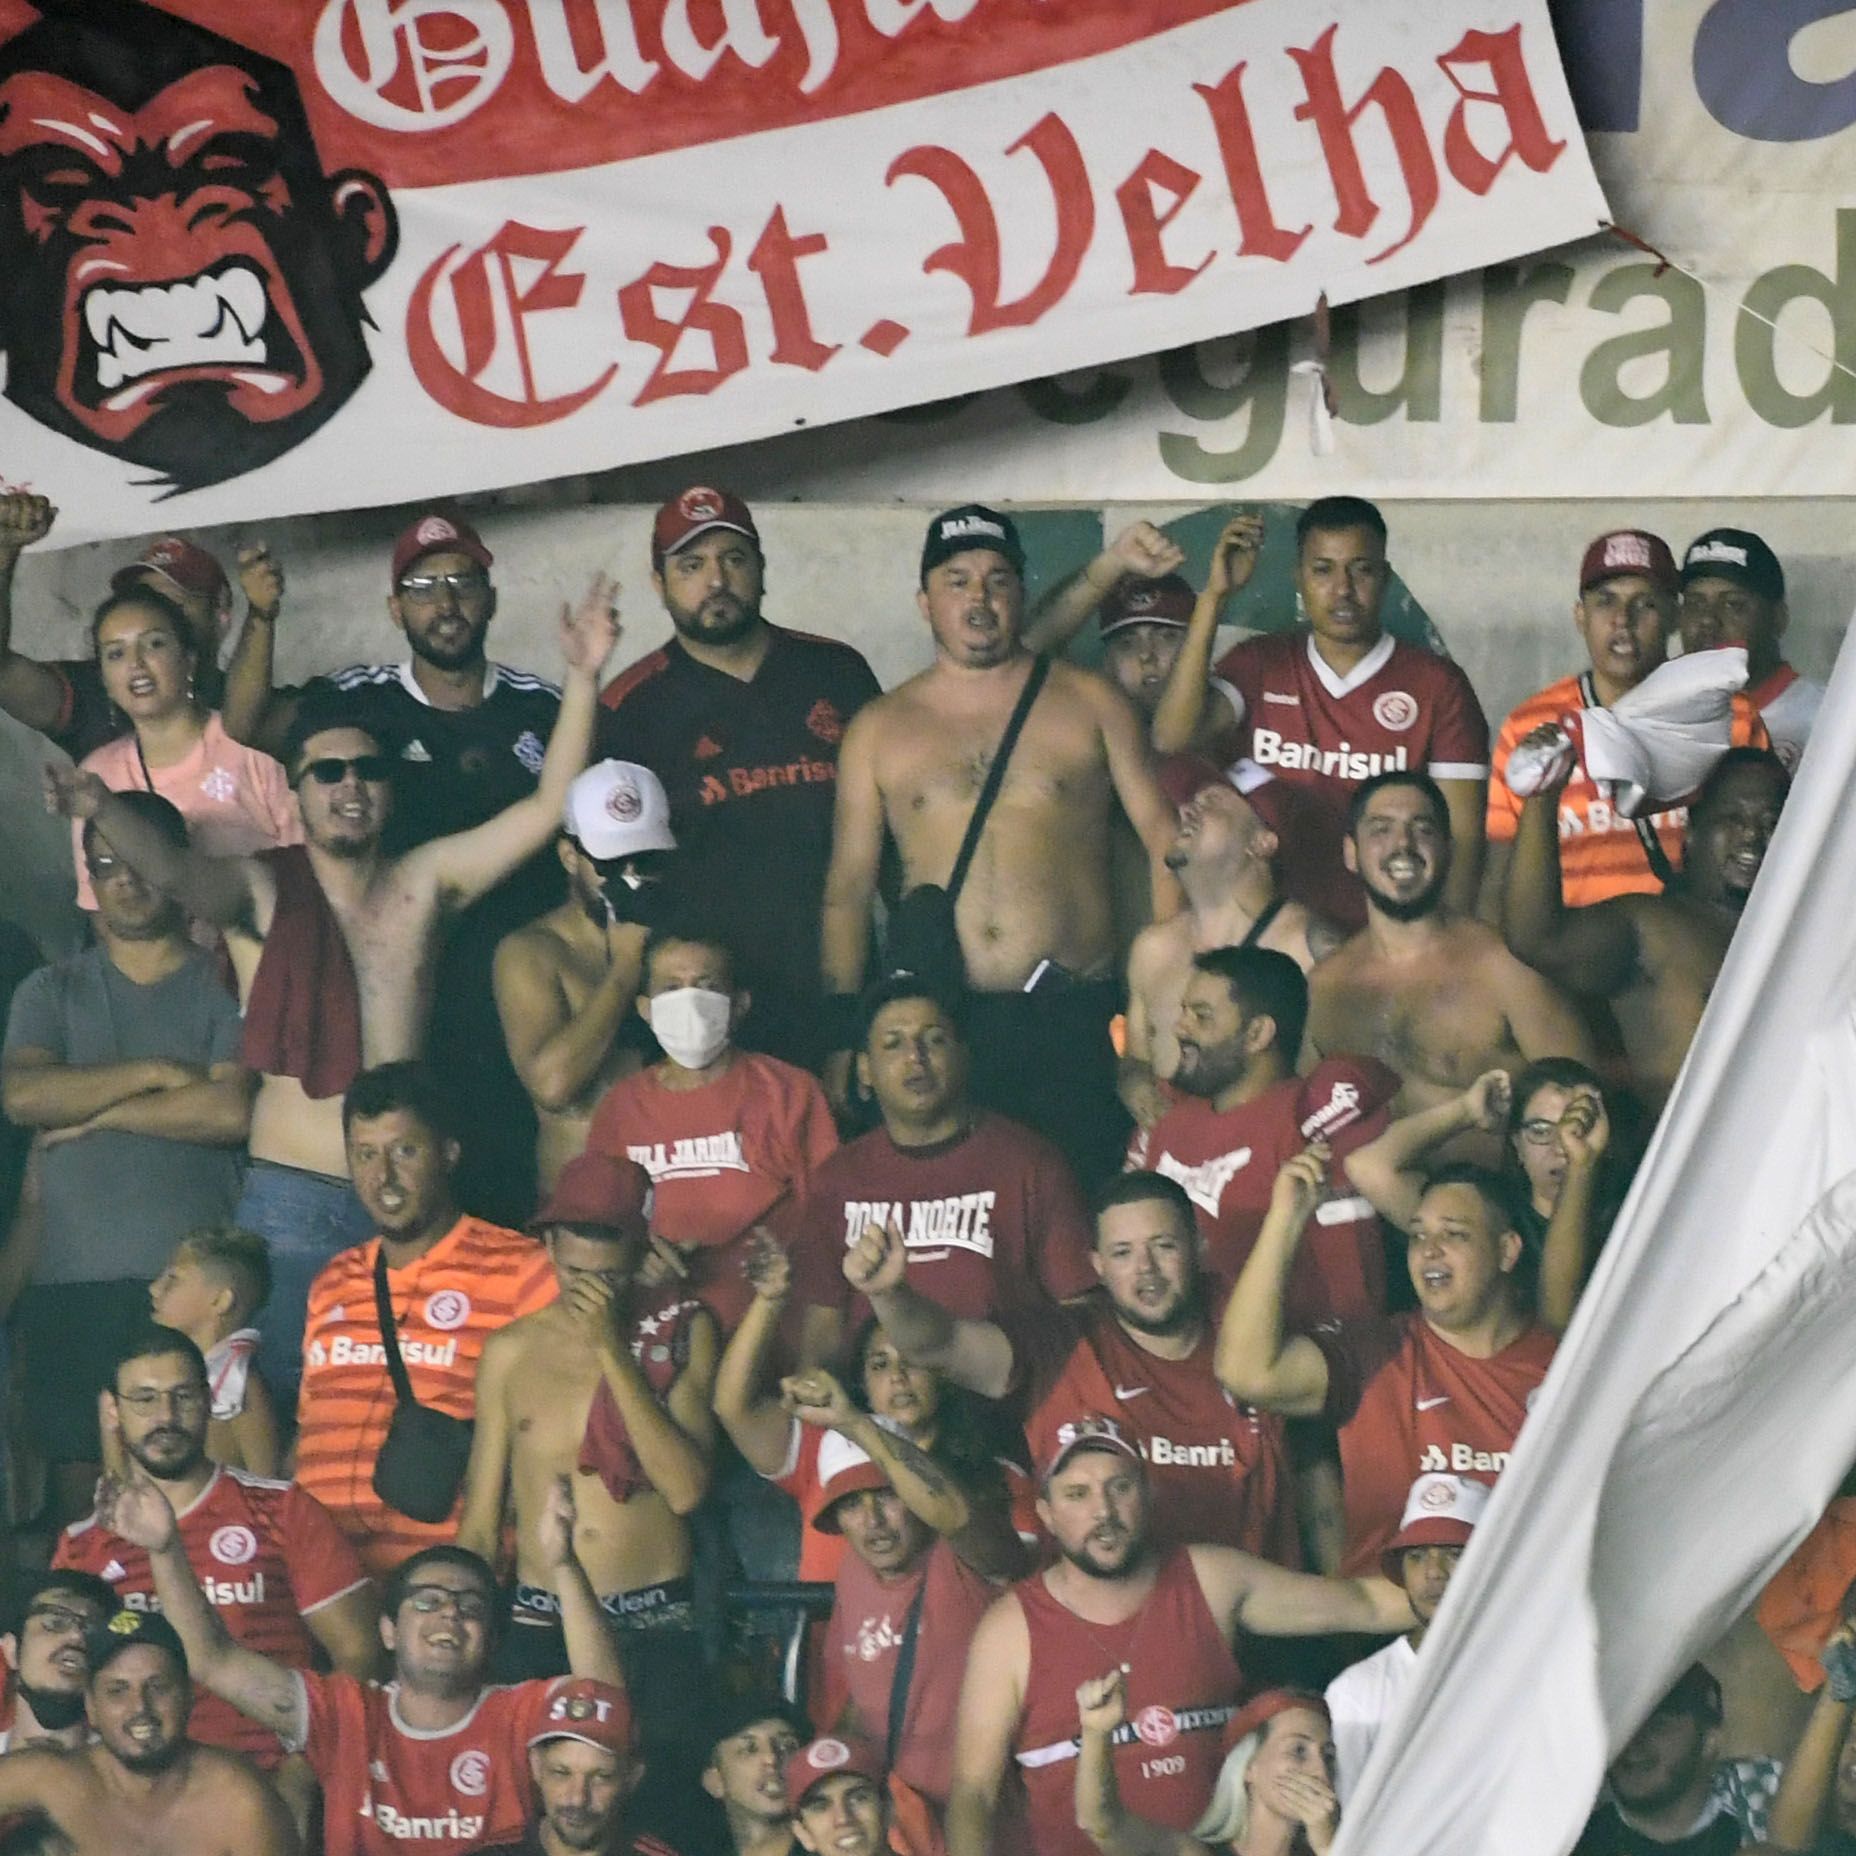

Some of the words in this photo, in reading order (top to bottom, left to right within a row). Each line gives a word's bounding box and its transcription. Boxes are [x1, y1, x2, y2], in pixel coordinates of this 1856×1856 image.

[884, 22, 1567, 337] Velha
[729, 757, 839, 797] Banris
[1253, 726, 1409, 781] Banrisul
[907, 1191, 993, 1249] NORTE
[331, 1336, 458, 1368] Banisul
